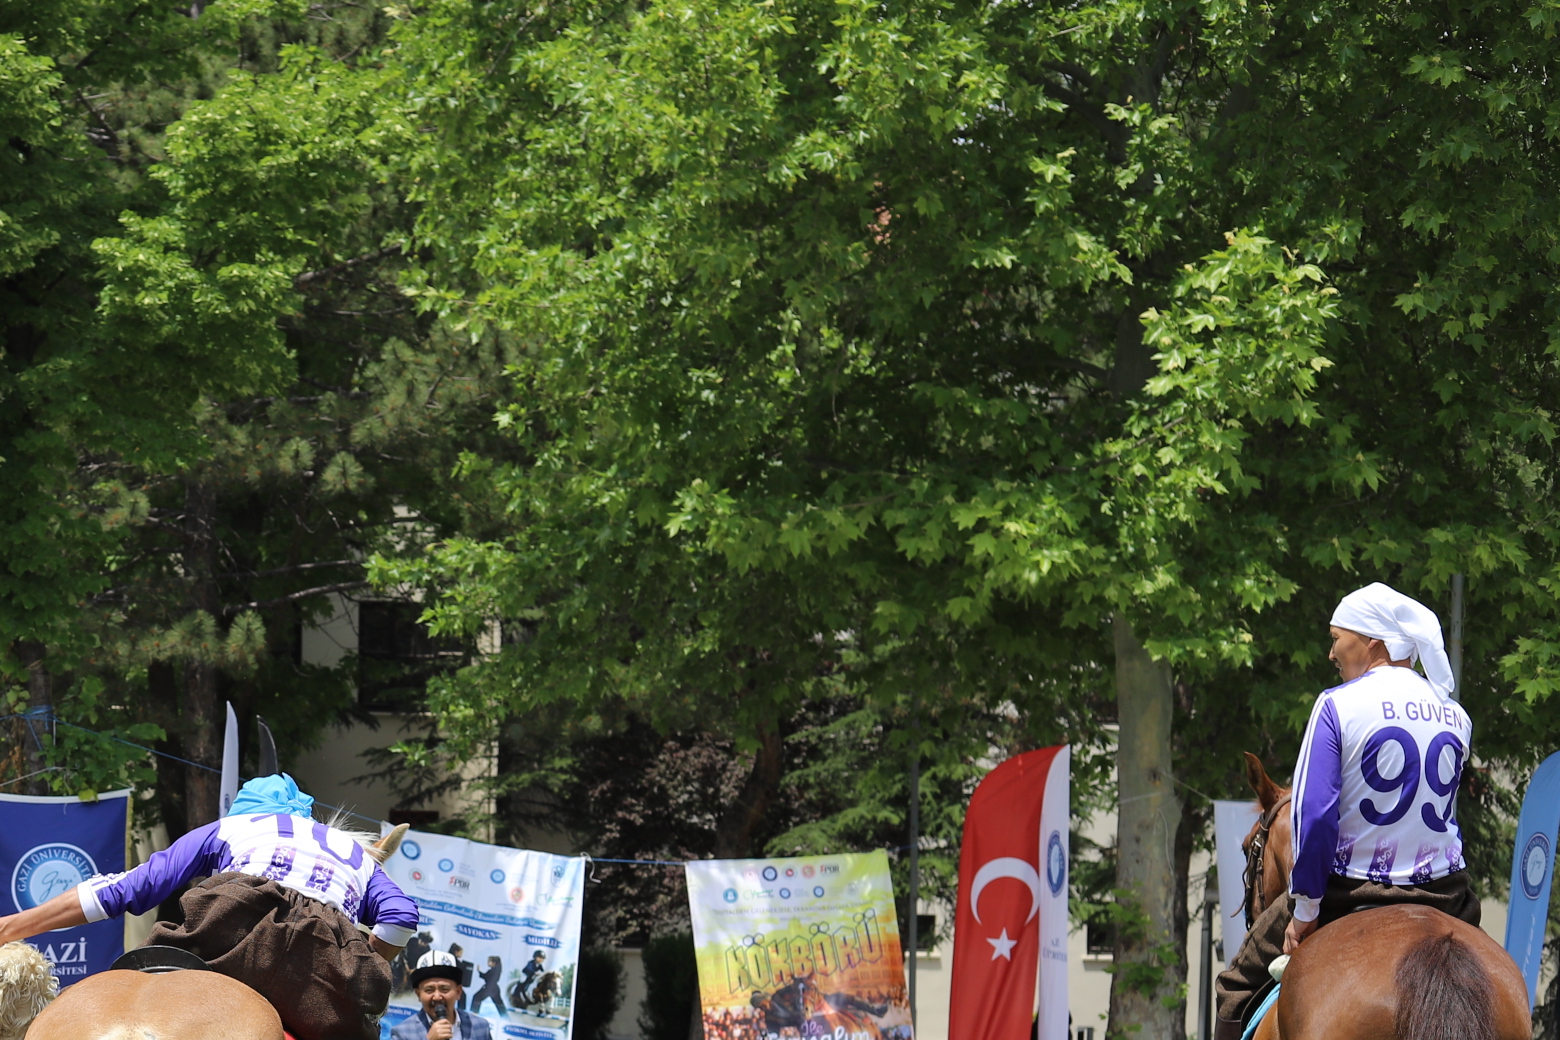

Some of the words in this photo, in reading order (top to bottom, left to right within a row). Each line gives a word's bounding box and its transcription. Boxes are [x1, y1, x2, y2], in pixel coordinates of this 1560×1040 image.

[1382, 701, 1400, 720] B.
[1406, 699, 1463, 731] GÜVEN
[1359, 726, 1464, 833] 99
[18, 862, 32, 893] GAZİ
[31, 848, 92, 880] ÜNİVERSİTE
[458, 924, 498, 940] SAYOKAN
[725, 907, 883, 995] KÖKBÖRÜ
[51, 966, 88, 976] RSİTESİ
